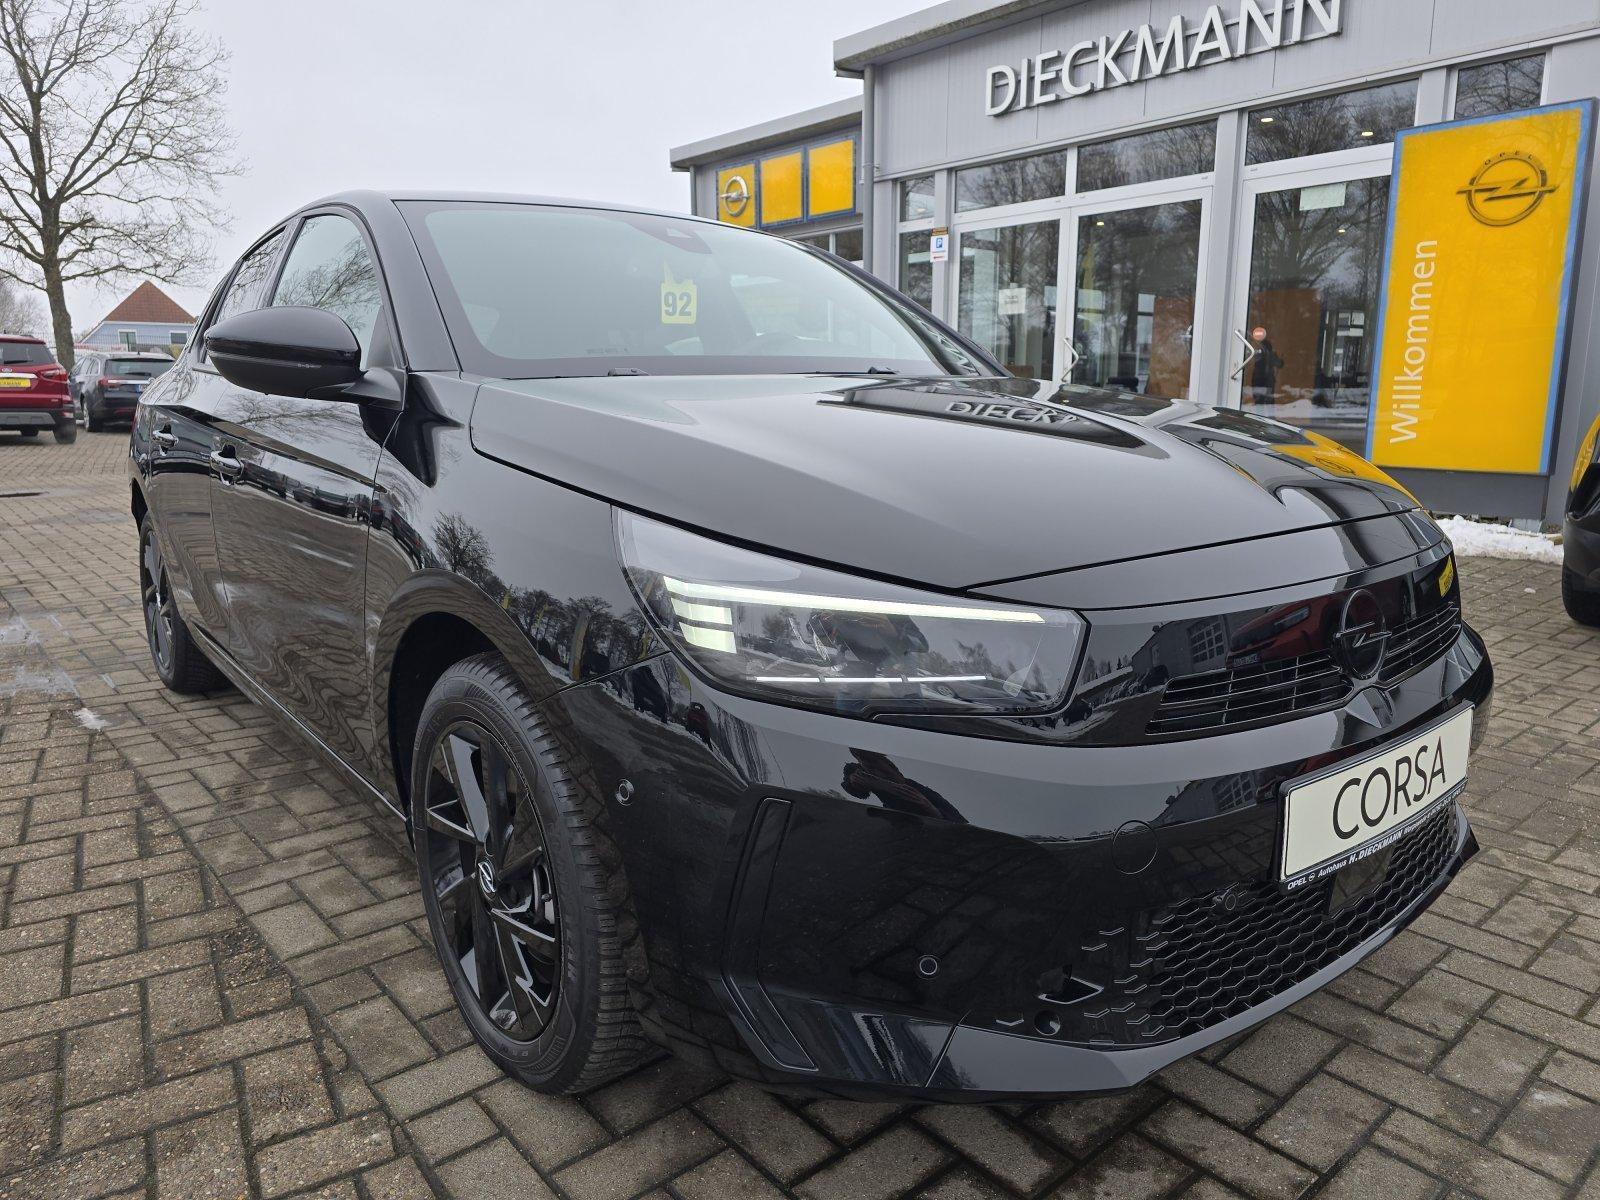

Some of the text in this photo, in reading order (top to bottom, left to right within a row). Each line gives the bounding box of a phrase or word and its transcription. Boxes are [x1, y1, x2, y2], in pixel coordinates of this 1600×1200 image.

[985, 0, 1342, 117] DIECKMANN
[663, 291, 692, 317] 92
[1389, 240, 1438, 444] Willkommen
[1332, 736, 1447, 840] CORSA
[1287, 876, 1308, 890] OPEL
[1317, 858, 1348, 878] Autohaus
